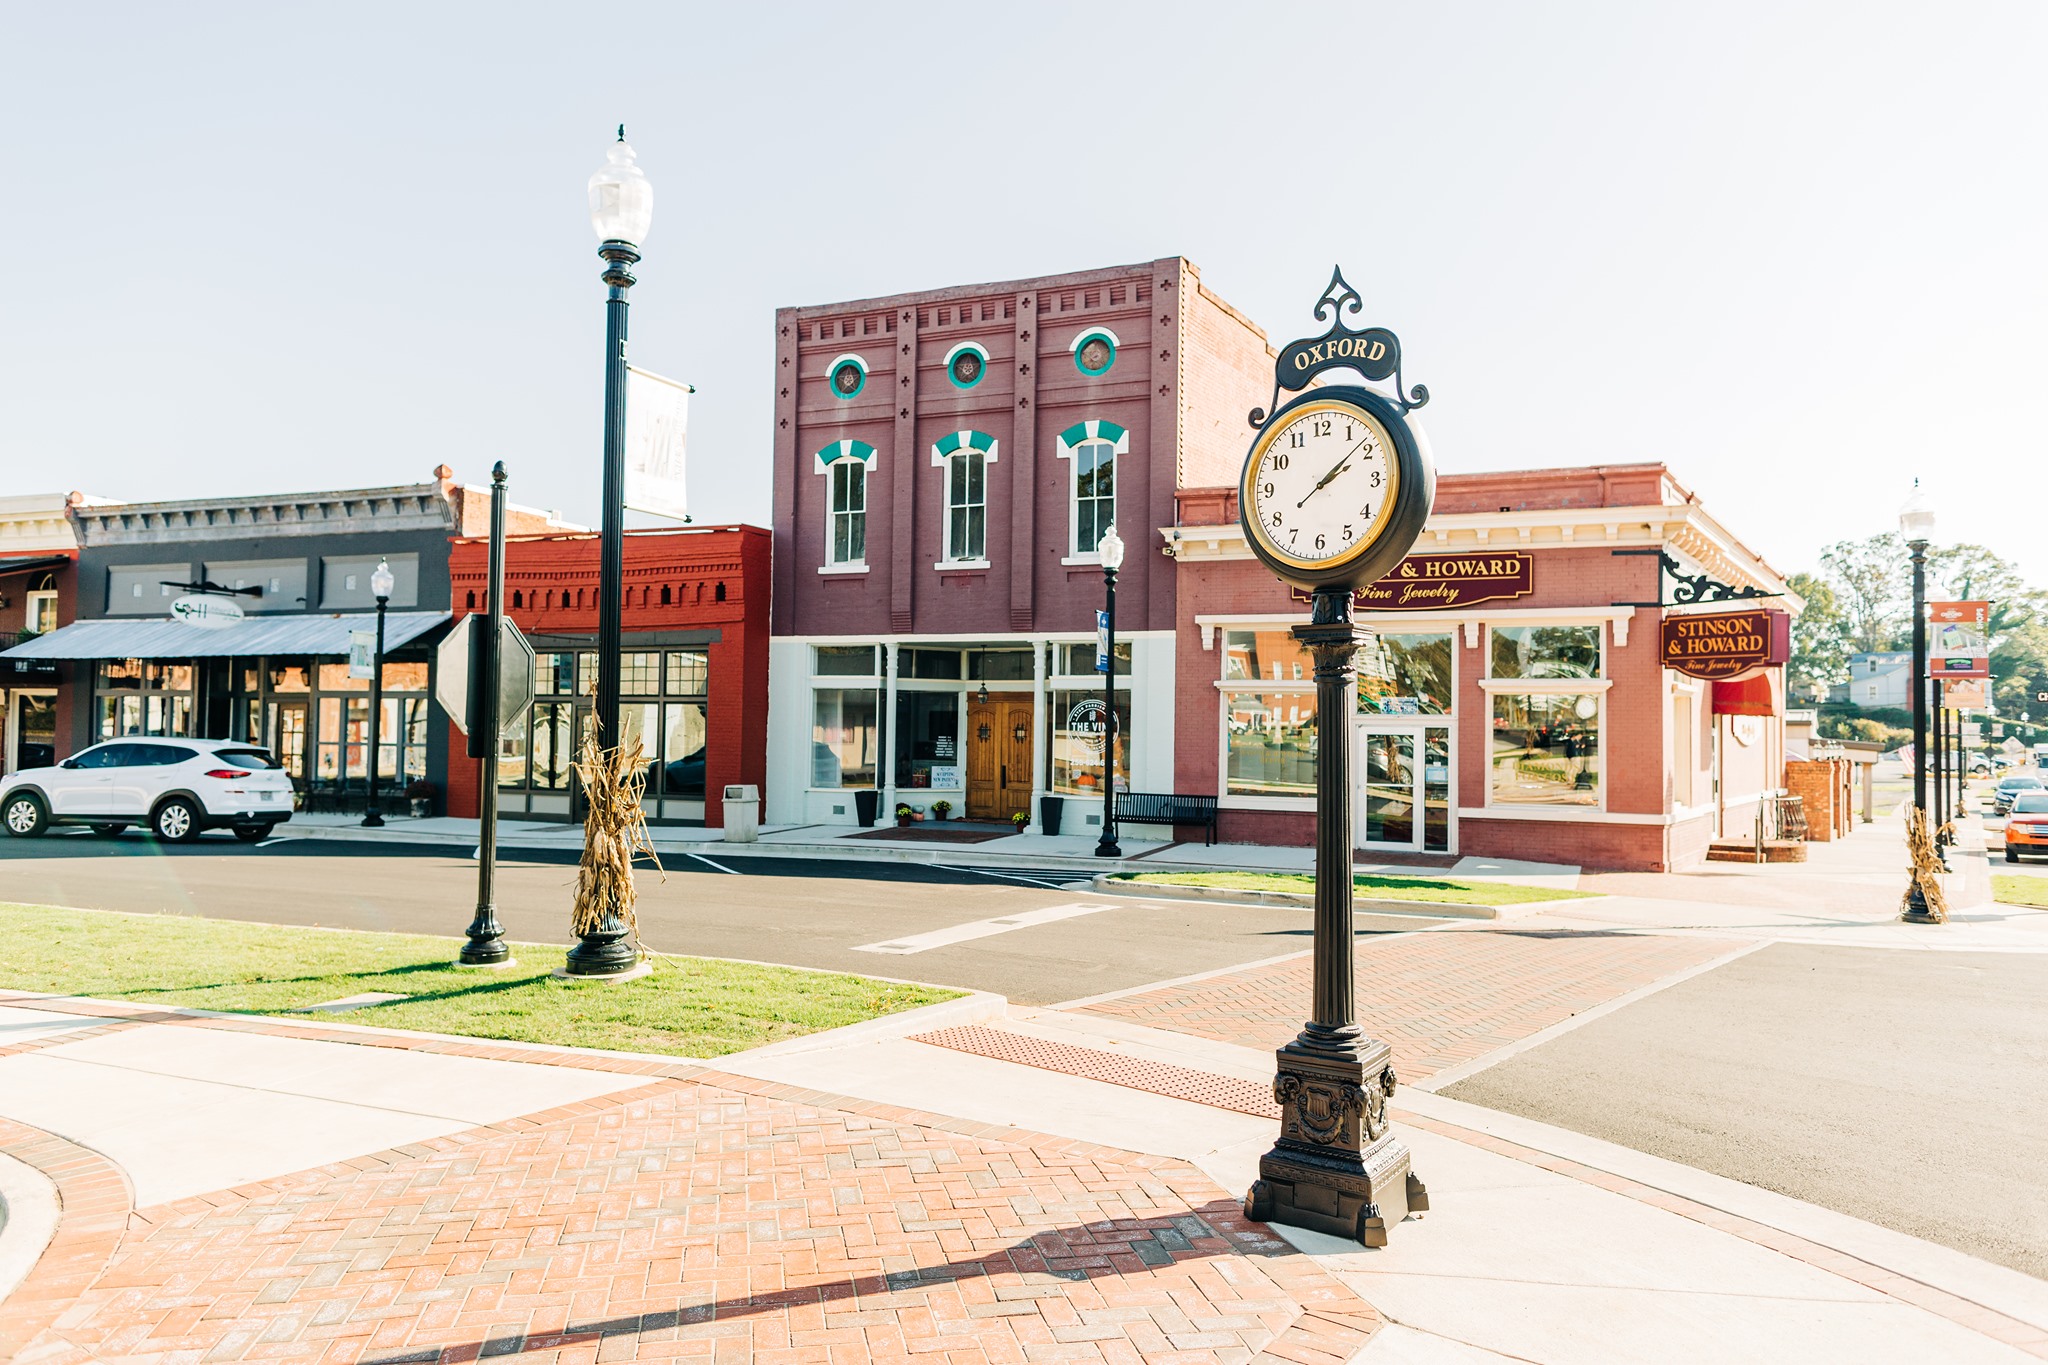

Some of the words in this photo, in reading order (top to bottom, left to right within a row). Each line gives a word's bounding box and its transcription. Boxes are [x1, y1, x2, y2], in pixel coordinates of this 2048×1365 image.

[1294, 338, 1386, 371] OXFORD
[1313, 420, 1331, 437] 12
[1345, 425, 1353, 441] 1
[1290, 432, 1306, 449] 11
[1363, 444, 1373, 460] 2
[1272, 454, 1289, 471] 10
[1370, 472, 1381, 488] 3
[1264, 482, 1275, 498] 9
[1273, 511, 1283, 527] 8
[1360, 503, 1371, 519] 4
[1289, 528, 1299, 544] 7
[1342, 524, 1353, 540] 5
[1315, 534, 1326, 550] 6
[1400, 562, 1419, 578] &
[1425, 559, 1521, 577] HOWARD
[1357, 584, 1393, 600] Fine
[1399, 582, 1460, 604] Jewelry
[1677, 617, 1754, 637] STINSON
[1976, 608, 1984, 630] SHOPS
[1668, 639, 1682, 655] &
[1687, 635, 1763, 654] HOWARD
[1685, 660, 1705, 670] Fine
[1705, 659, 1742, 673] Jewelry
[1071, 721, 1090, 732] THE
[1092, 721, 1107, 732] VIN
